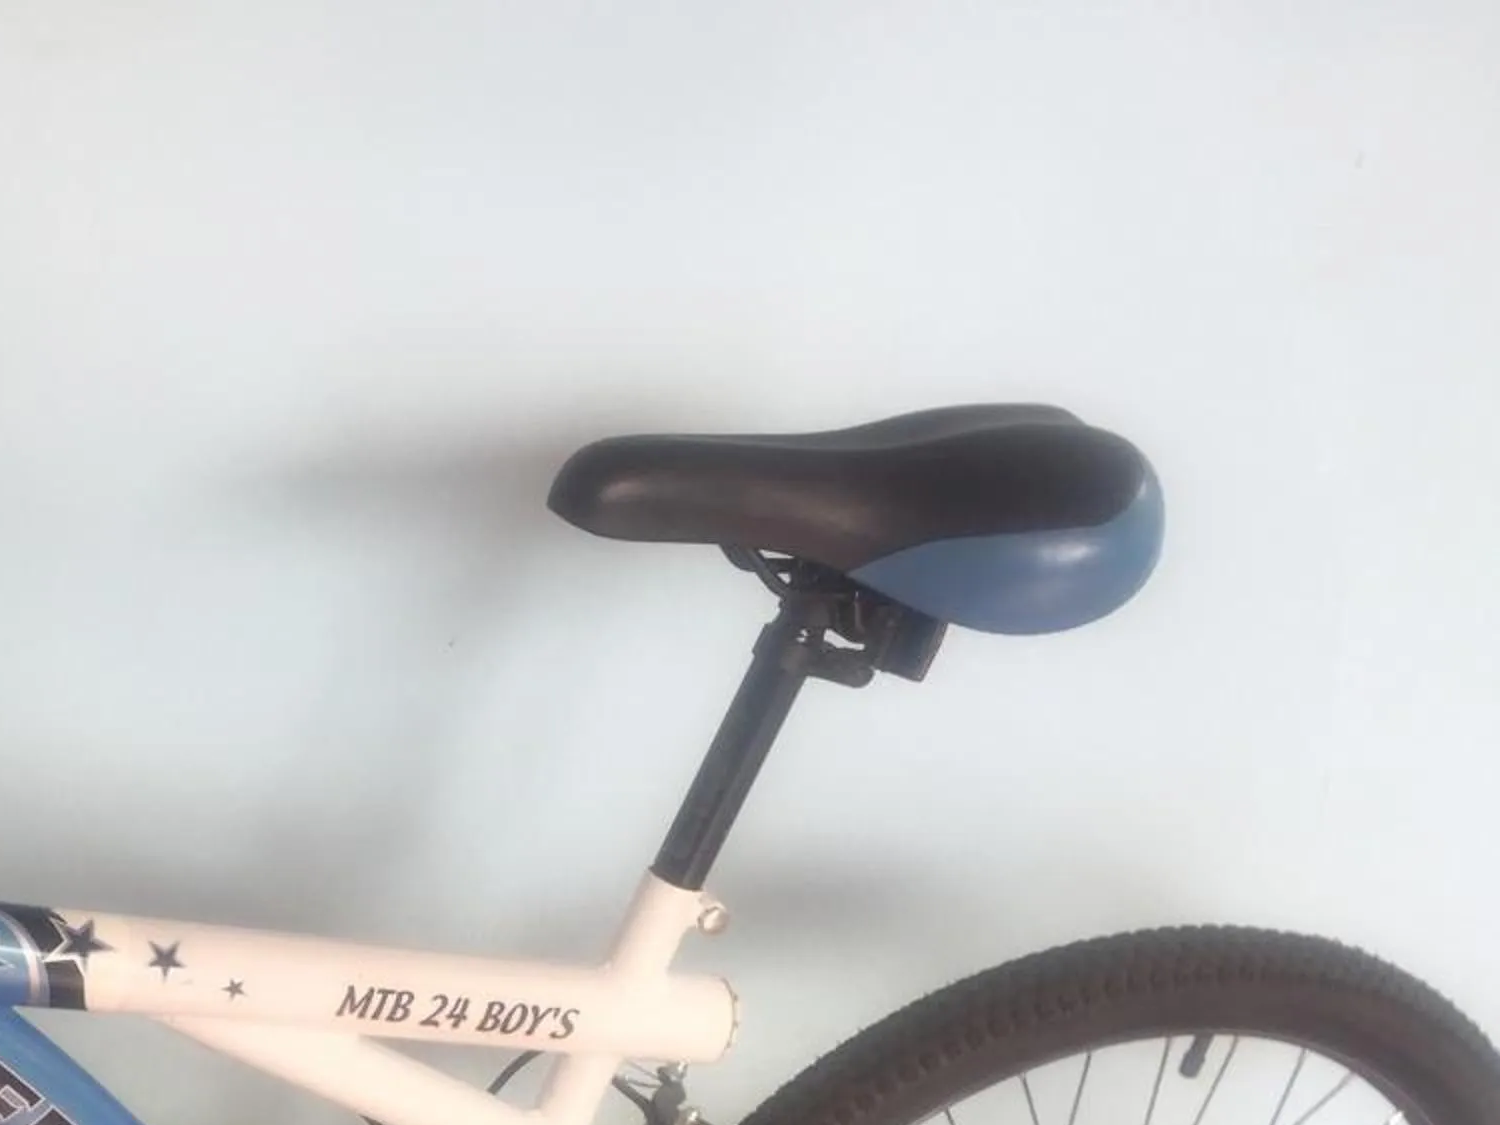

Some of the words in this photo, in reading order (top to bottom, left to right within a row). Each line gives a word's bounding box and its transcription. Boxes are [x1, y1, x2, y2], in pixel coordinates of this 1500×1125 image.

[335, 984, 415, 1023] MTB
[419, 994, 471, 1030] 24
[476, 1000, 581, 1039] BOY'S
